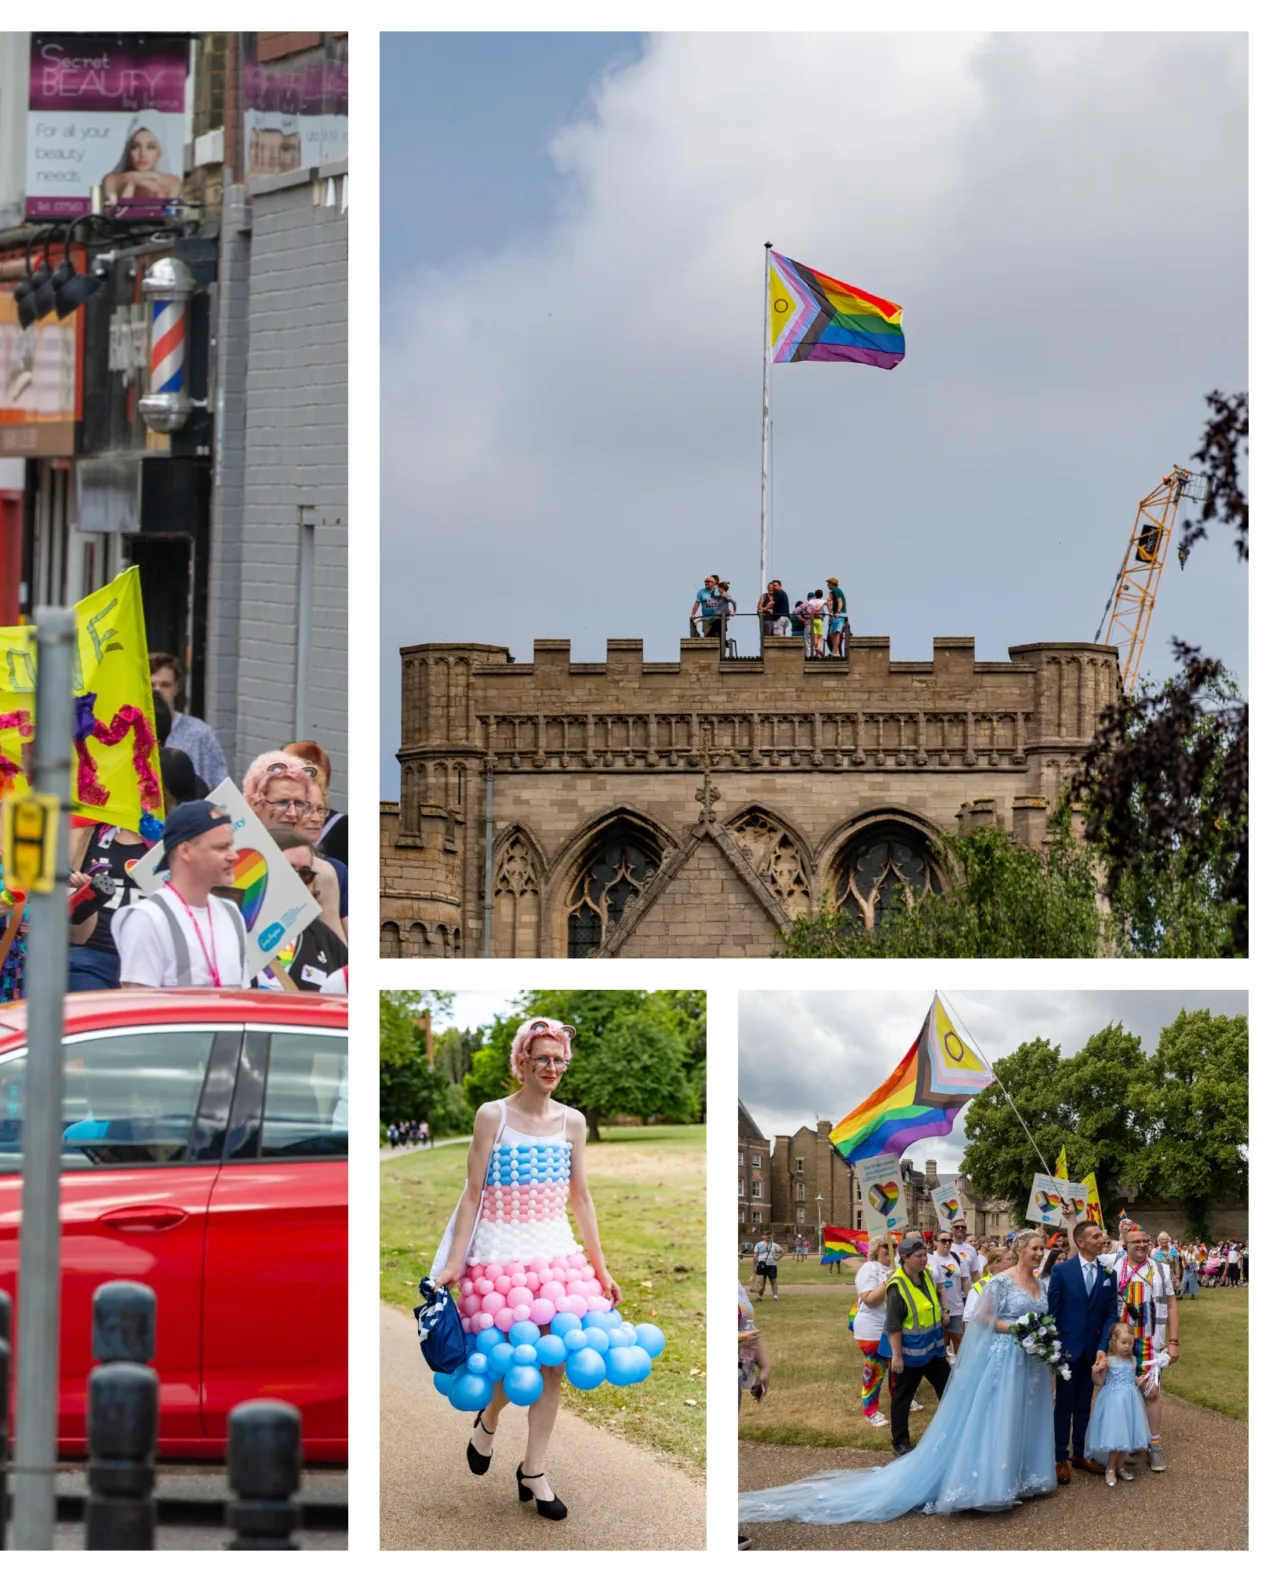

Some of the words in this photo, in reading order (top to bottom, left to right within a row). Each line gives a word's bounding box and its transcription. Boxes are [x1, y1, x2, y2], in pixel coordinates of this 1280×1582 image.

[41, 44, 111, 70] Secret
[42, 68, 164, 98] BEAUTY
[36, 123, 57, 138] For
[63, 123, 76, 138] all
[79, 127, 110, 141] your
[36, 147, 85, 163] beauty
[36, 170, 81, 183] needs
